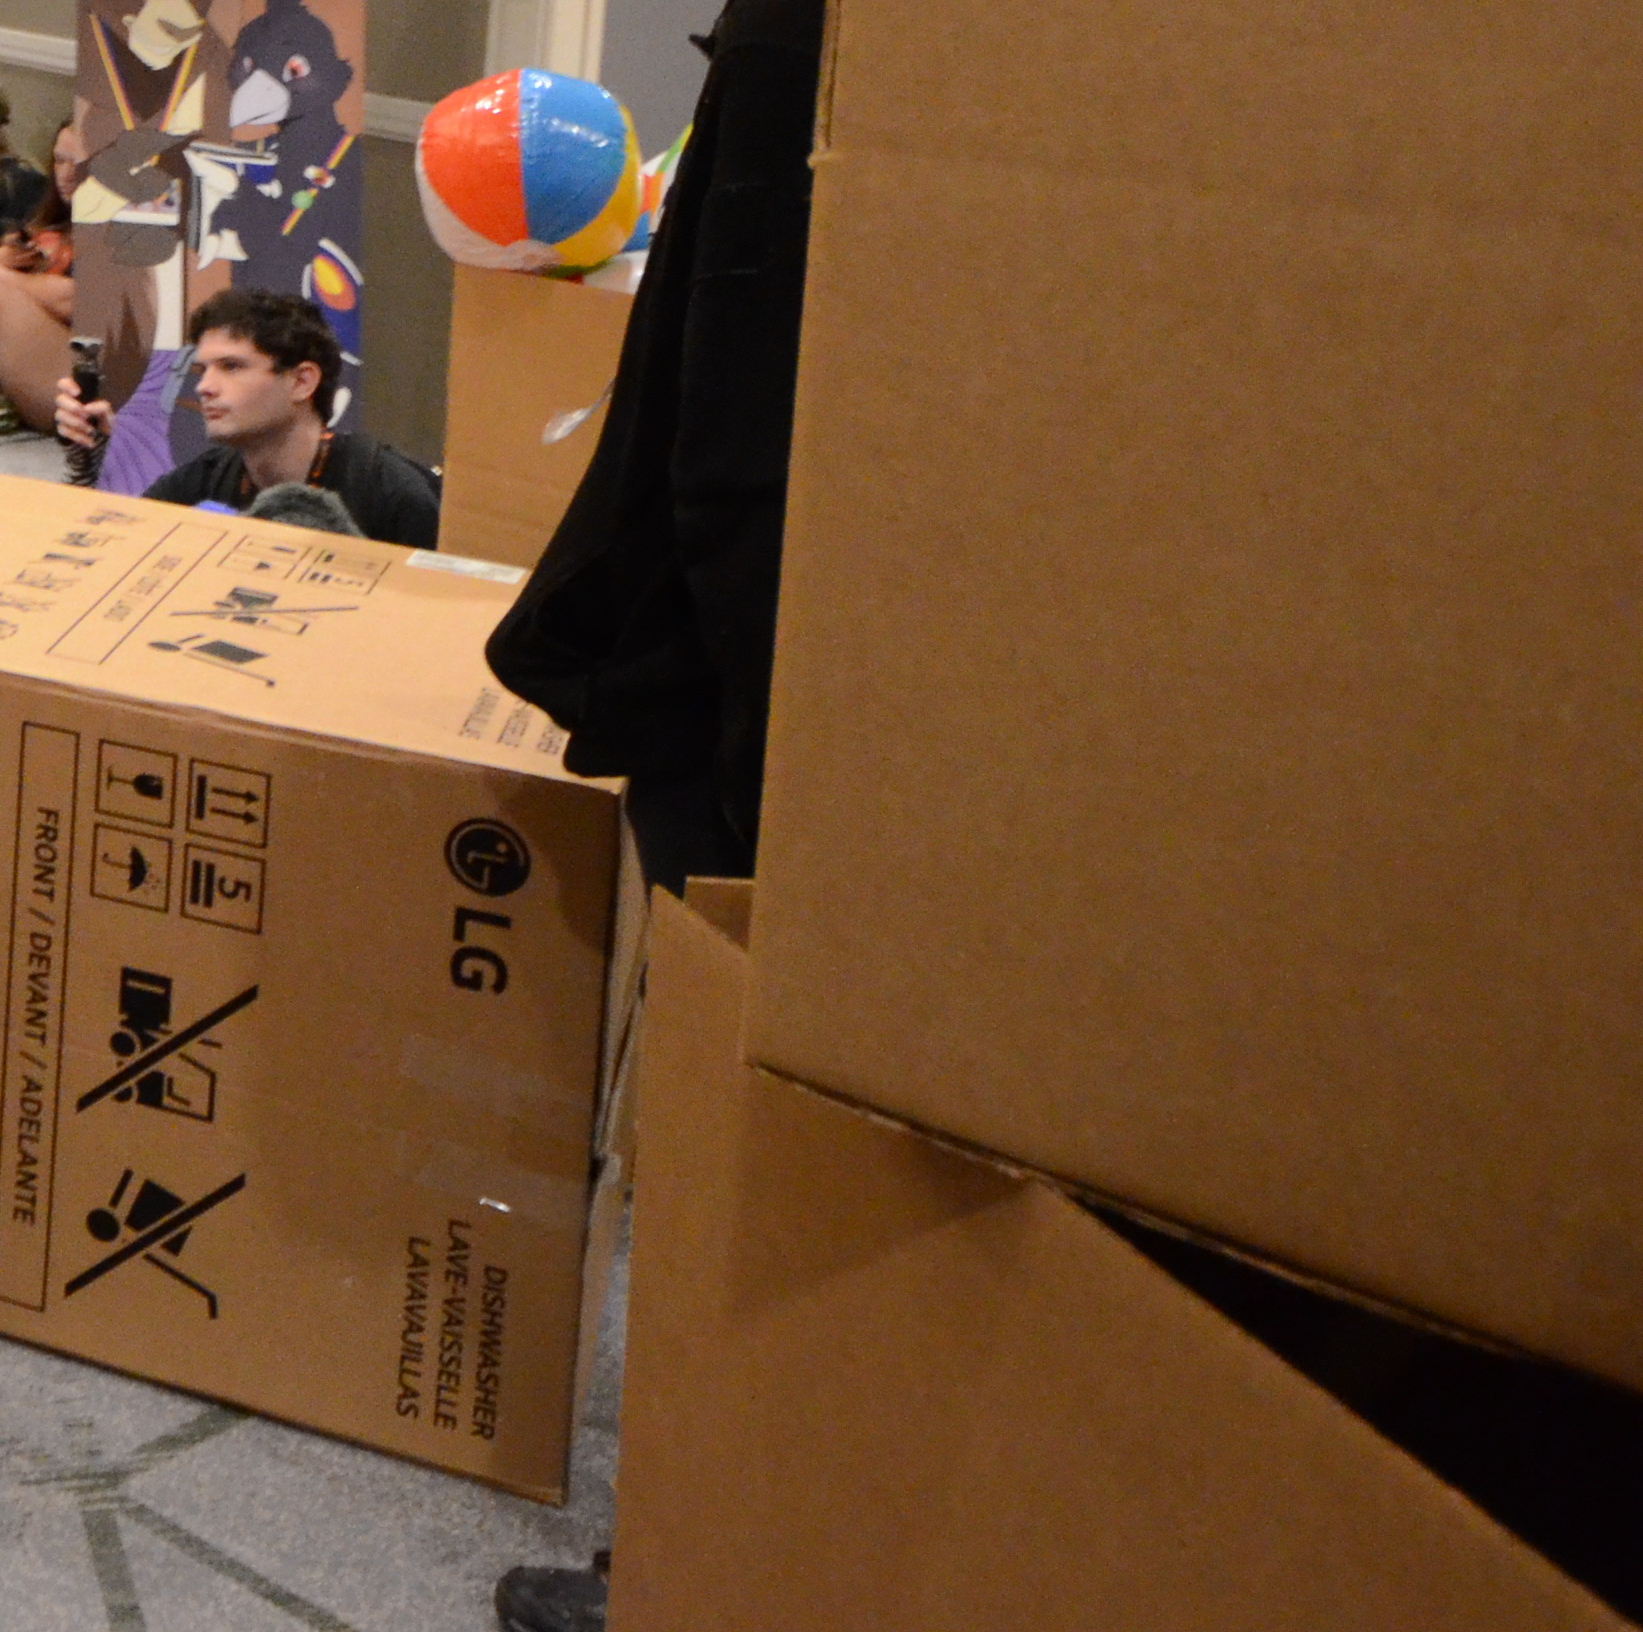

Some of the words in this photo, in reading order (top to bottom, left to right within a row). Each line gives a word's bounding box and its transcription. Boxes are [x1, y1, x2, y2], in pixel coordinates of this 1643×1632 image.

[33, 806, 59, 903] FRONT
[218, 875, 253, 903] 5
[28, 904, 56, 926] /
[447, 905, 513, 997] LG
[24, 930, 52, 1046] DEVANT
[19, 1048, 47, 1070] /
[12, 1073, 44, 1225] ADELANTE
[395, 1235, 431, 1421] LAVAVAJILLAS
[433, 1217, 472, 1432] LAVE-VAISSELLE
[470, 1264, 509, 1442] DISHWASHER
